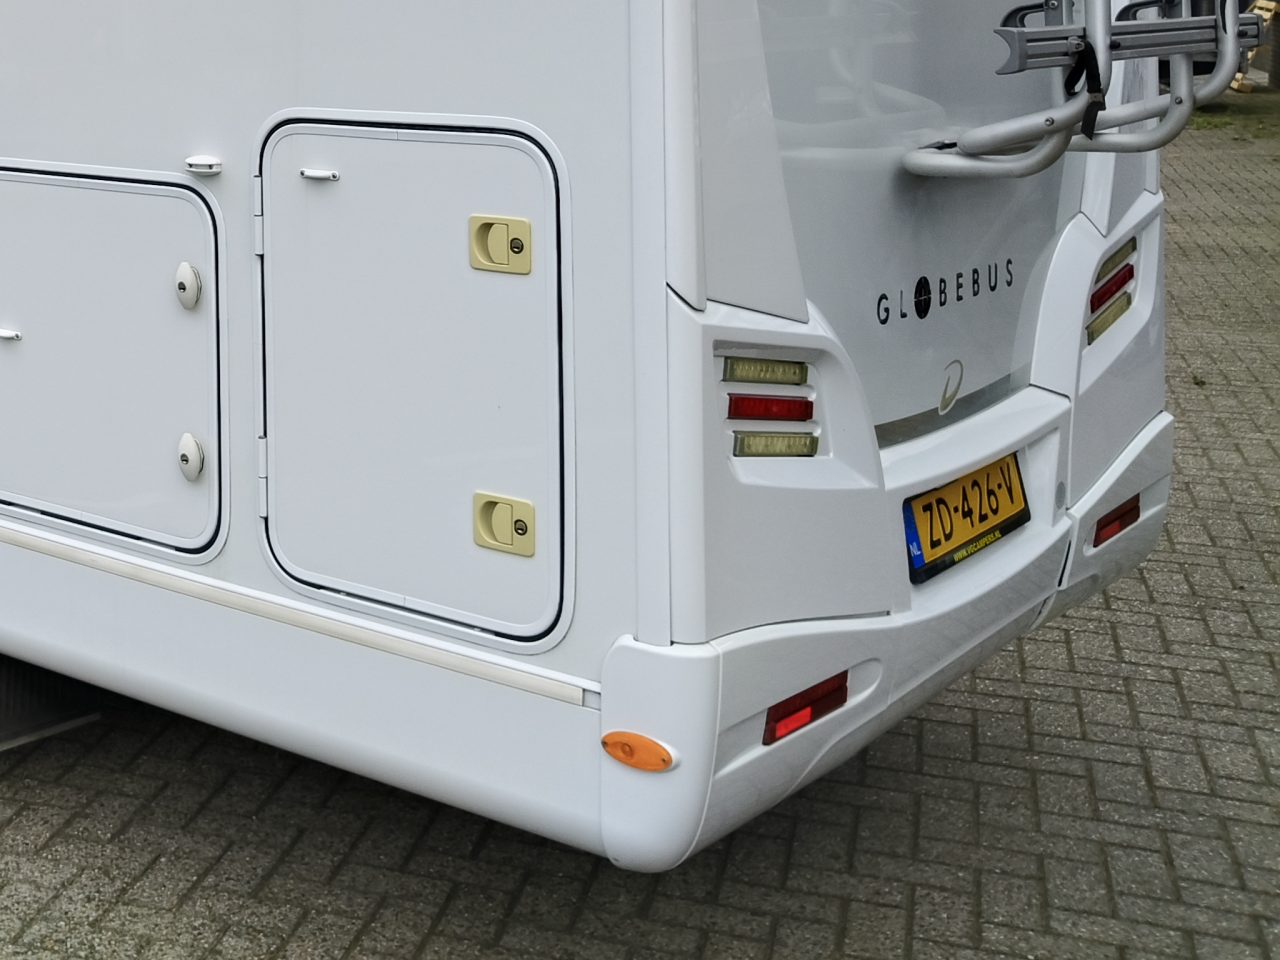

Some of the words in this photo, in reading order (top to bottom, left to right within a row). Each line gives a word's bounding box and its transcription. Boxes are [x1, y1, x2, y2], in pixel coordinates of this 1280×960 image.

[876, 258, 1014, 325] GLOBEBUS
[922, 462, 1015, 550] ZD-426-V
[910, 541, 921, 556] NL
